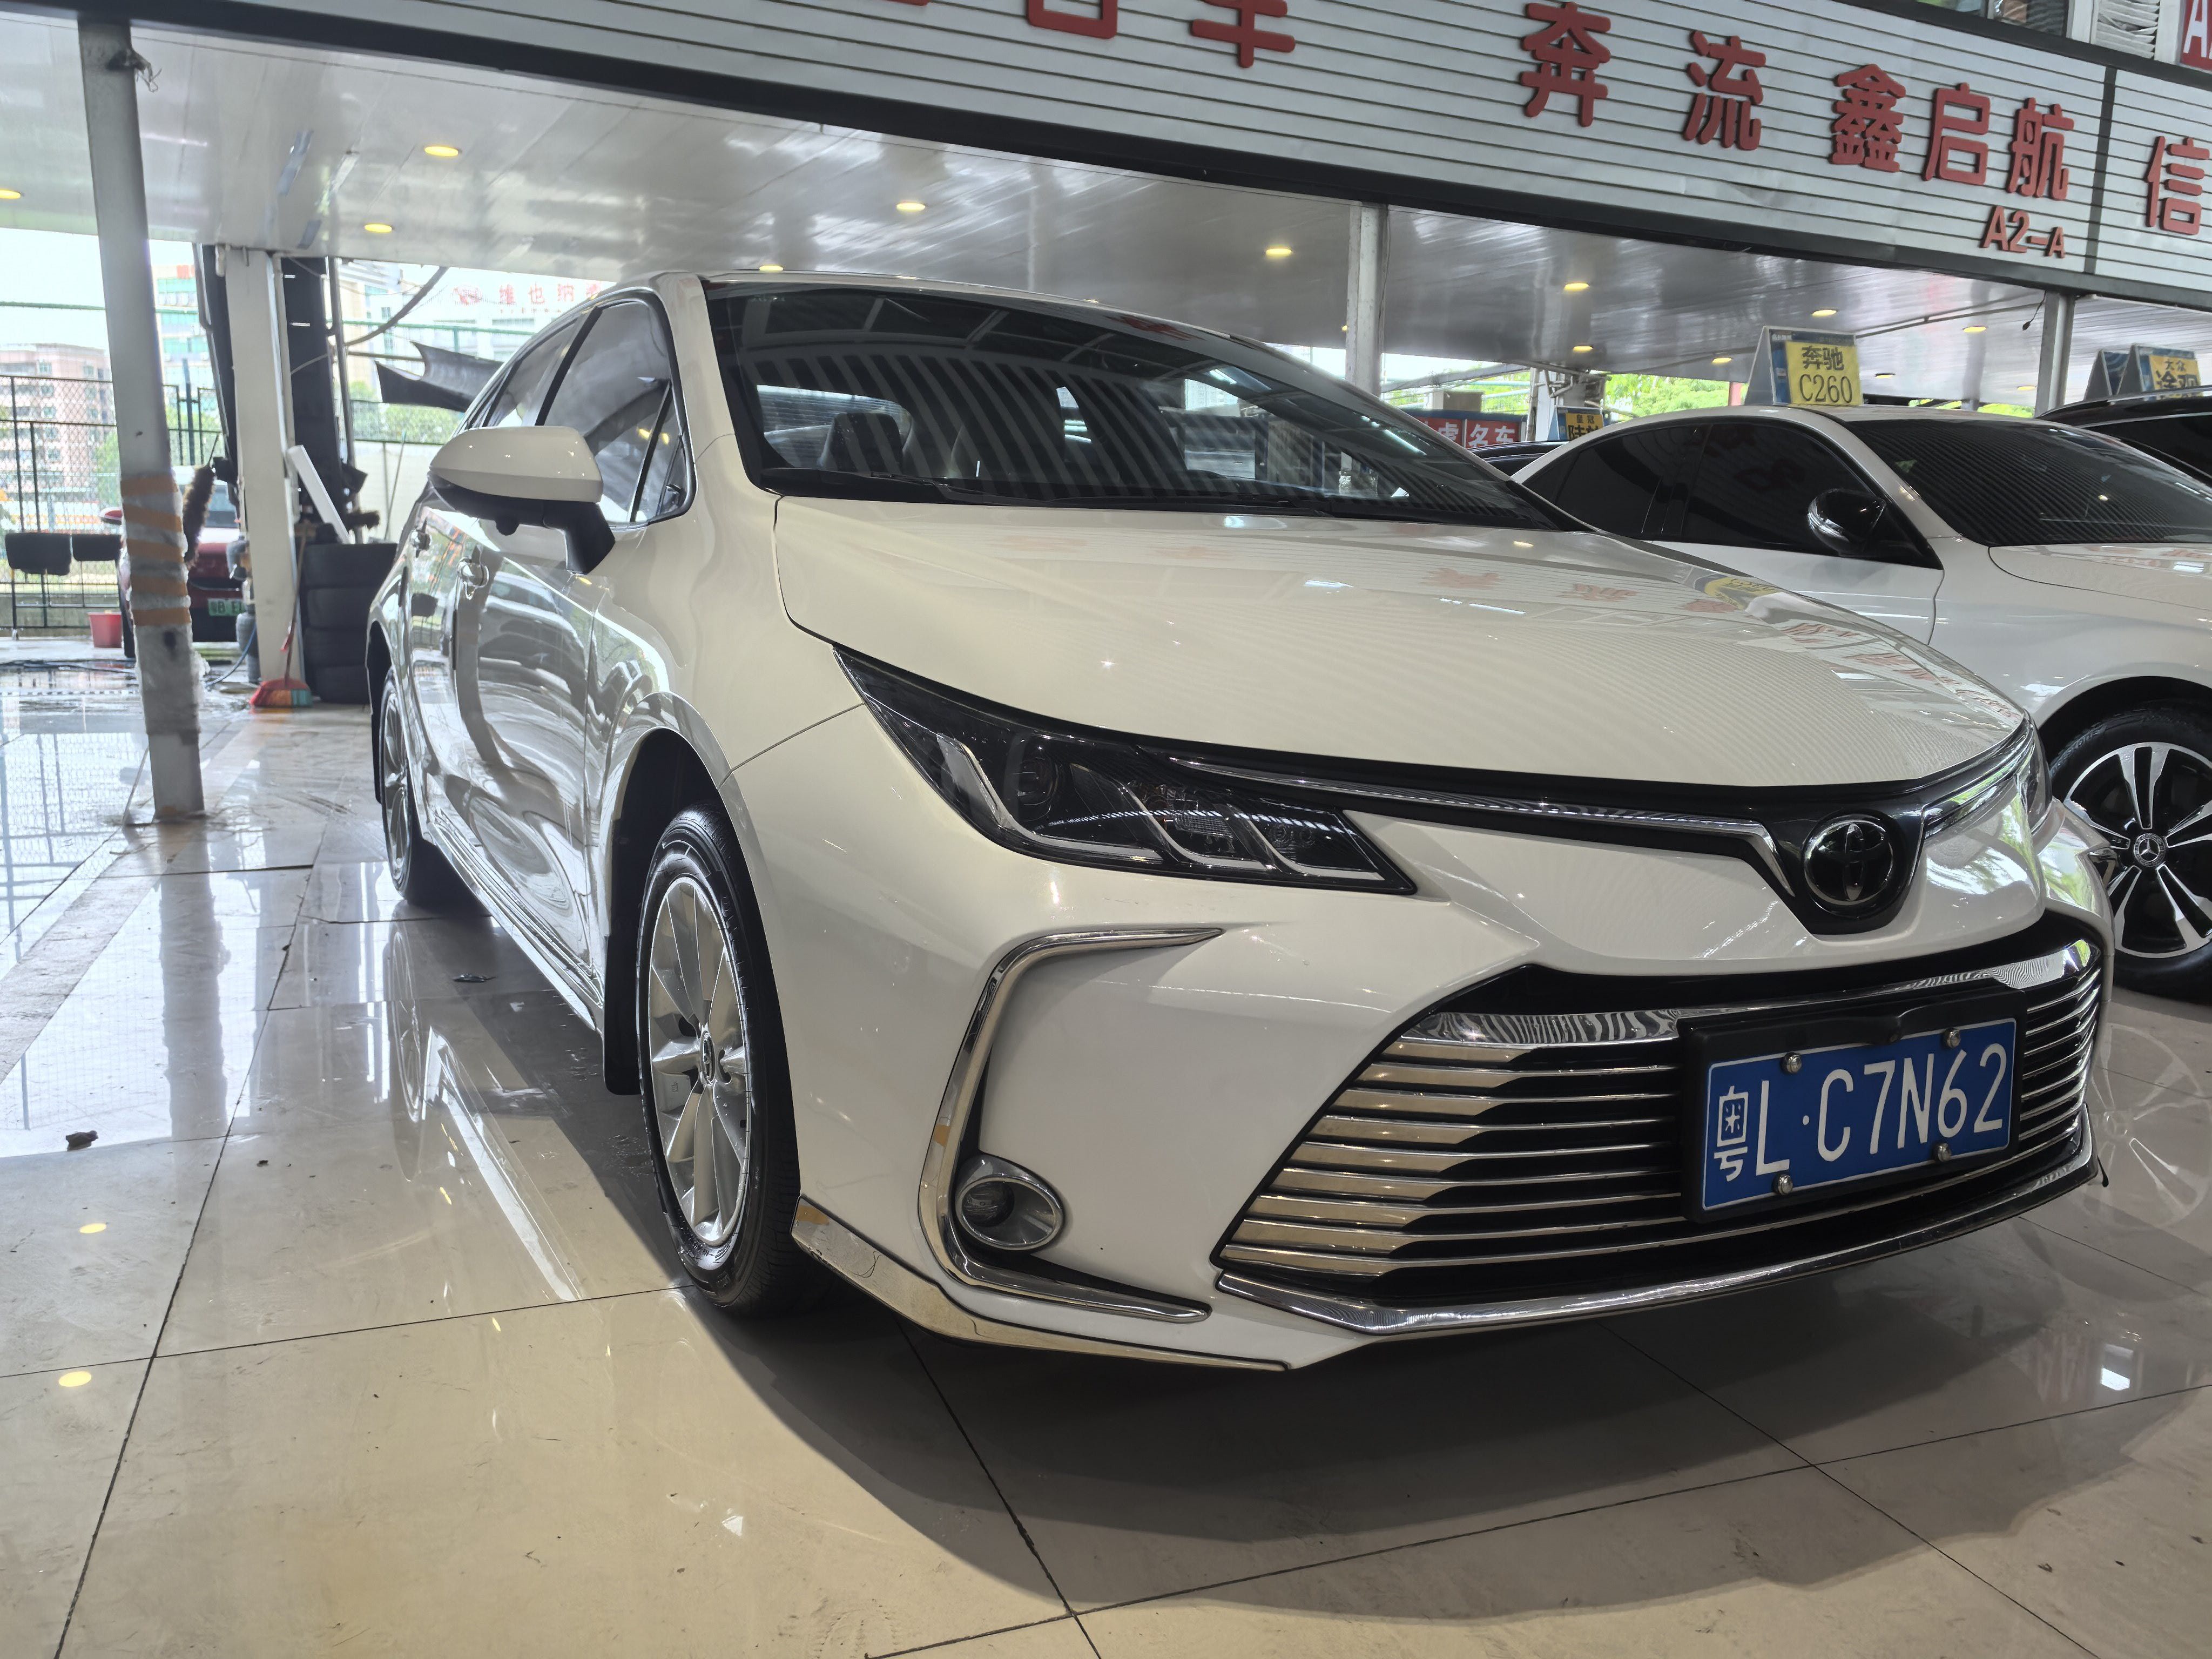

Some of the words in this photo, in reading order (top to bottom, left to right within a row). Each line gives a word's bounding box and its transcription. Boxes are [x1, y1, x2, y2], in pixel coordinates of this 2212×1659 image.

[2183, 0, 2212, 59] A
[2143, 136, 2210, 235] 信
[1802, 345, 1845, 370] 奔驰
[1799, 374, 1852, 403] C260
[1714, 1043, 2007, 1182] 粤L·C7N62
